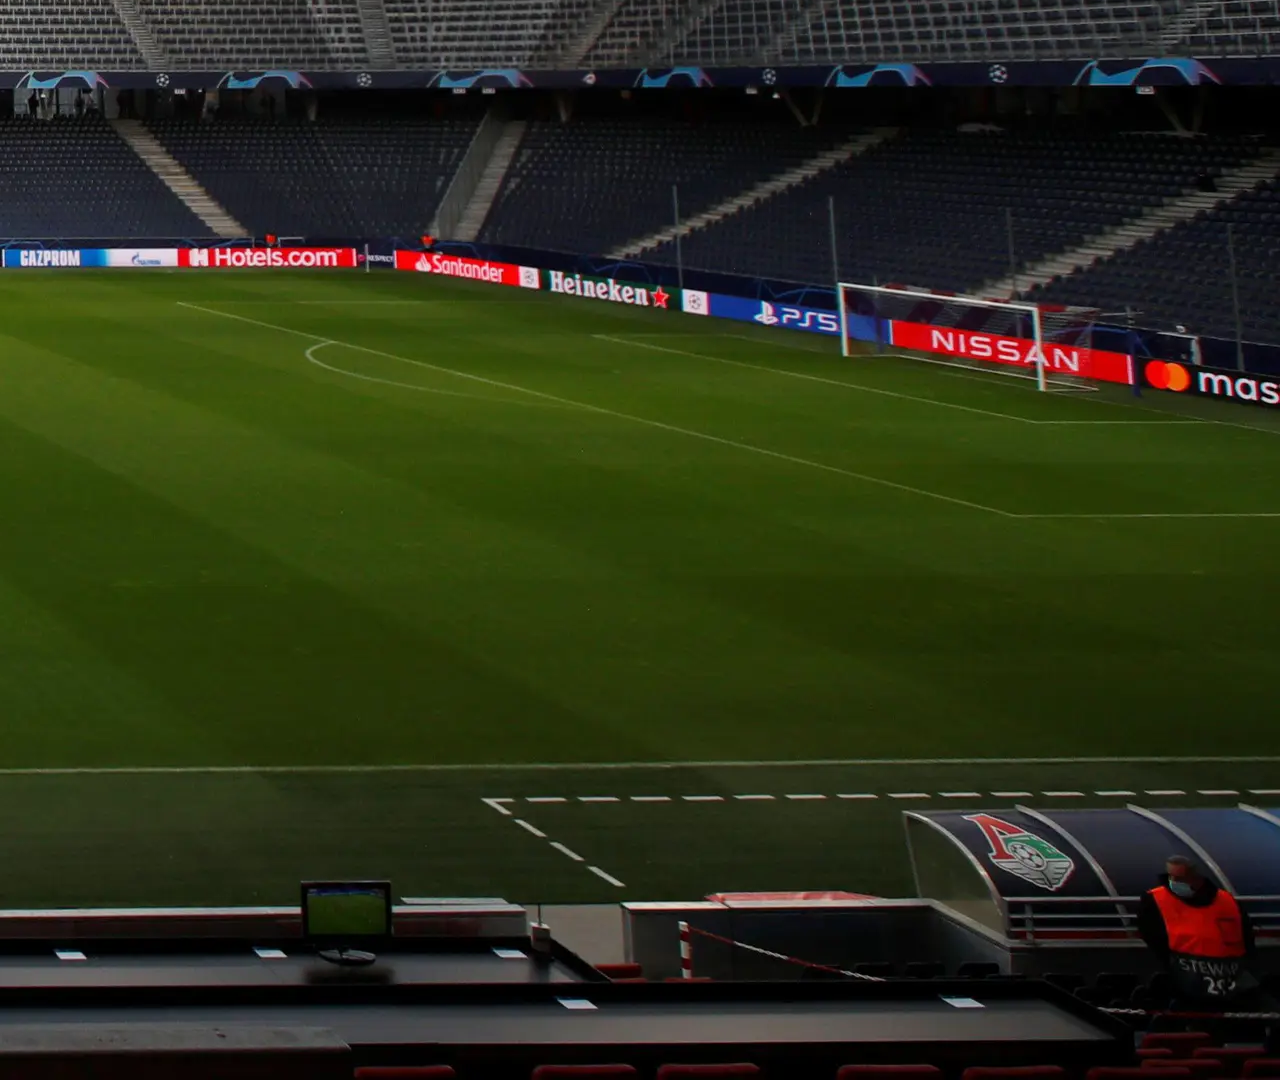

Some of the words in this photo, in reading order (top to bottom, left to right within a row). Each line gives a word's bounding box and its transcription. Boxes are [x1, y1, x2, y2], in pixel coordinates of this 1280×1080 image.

[20, 249, 81, 266] GAZPROM
[214, 247, 338, 268] Hotels.com
[432, 255, 504, 283] Santander
[549, 270, 649, 306] Heineken
[781, 306, 838, 332] PS5
[931, 329, 1080, 372] NISSAN
